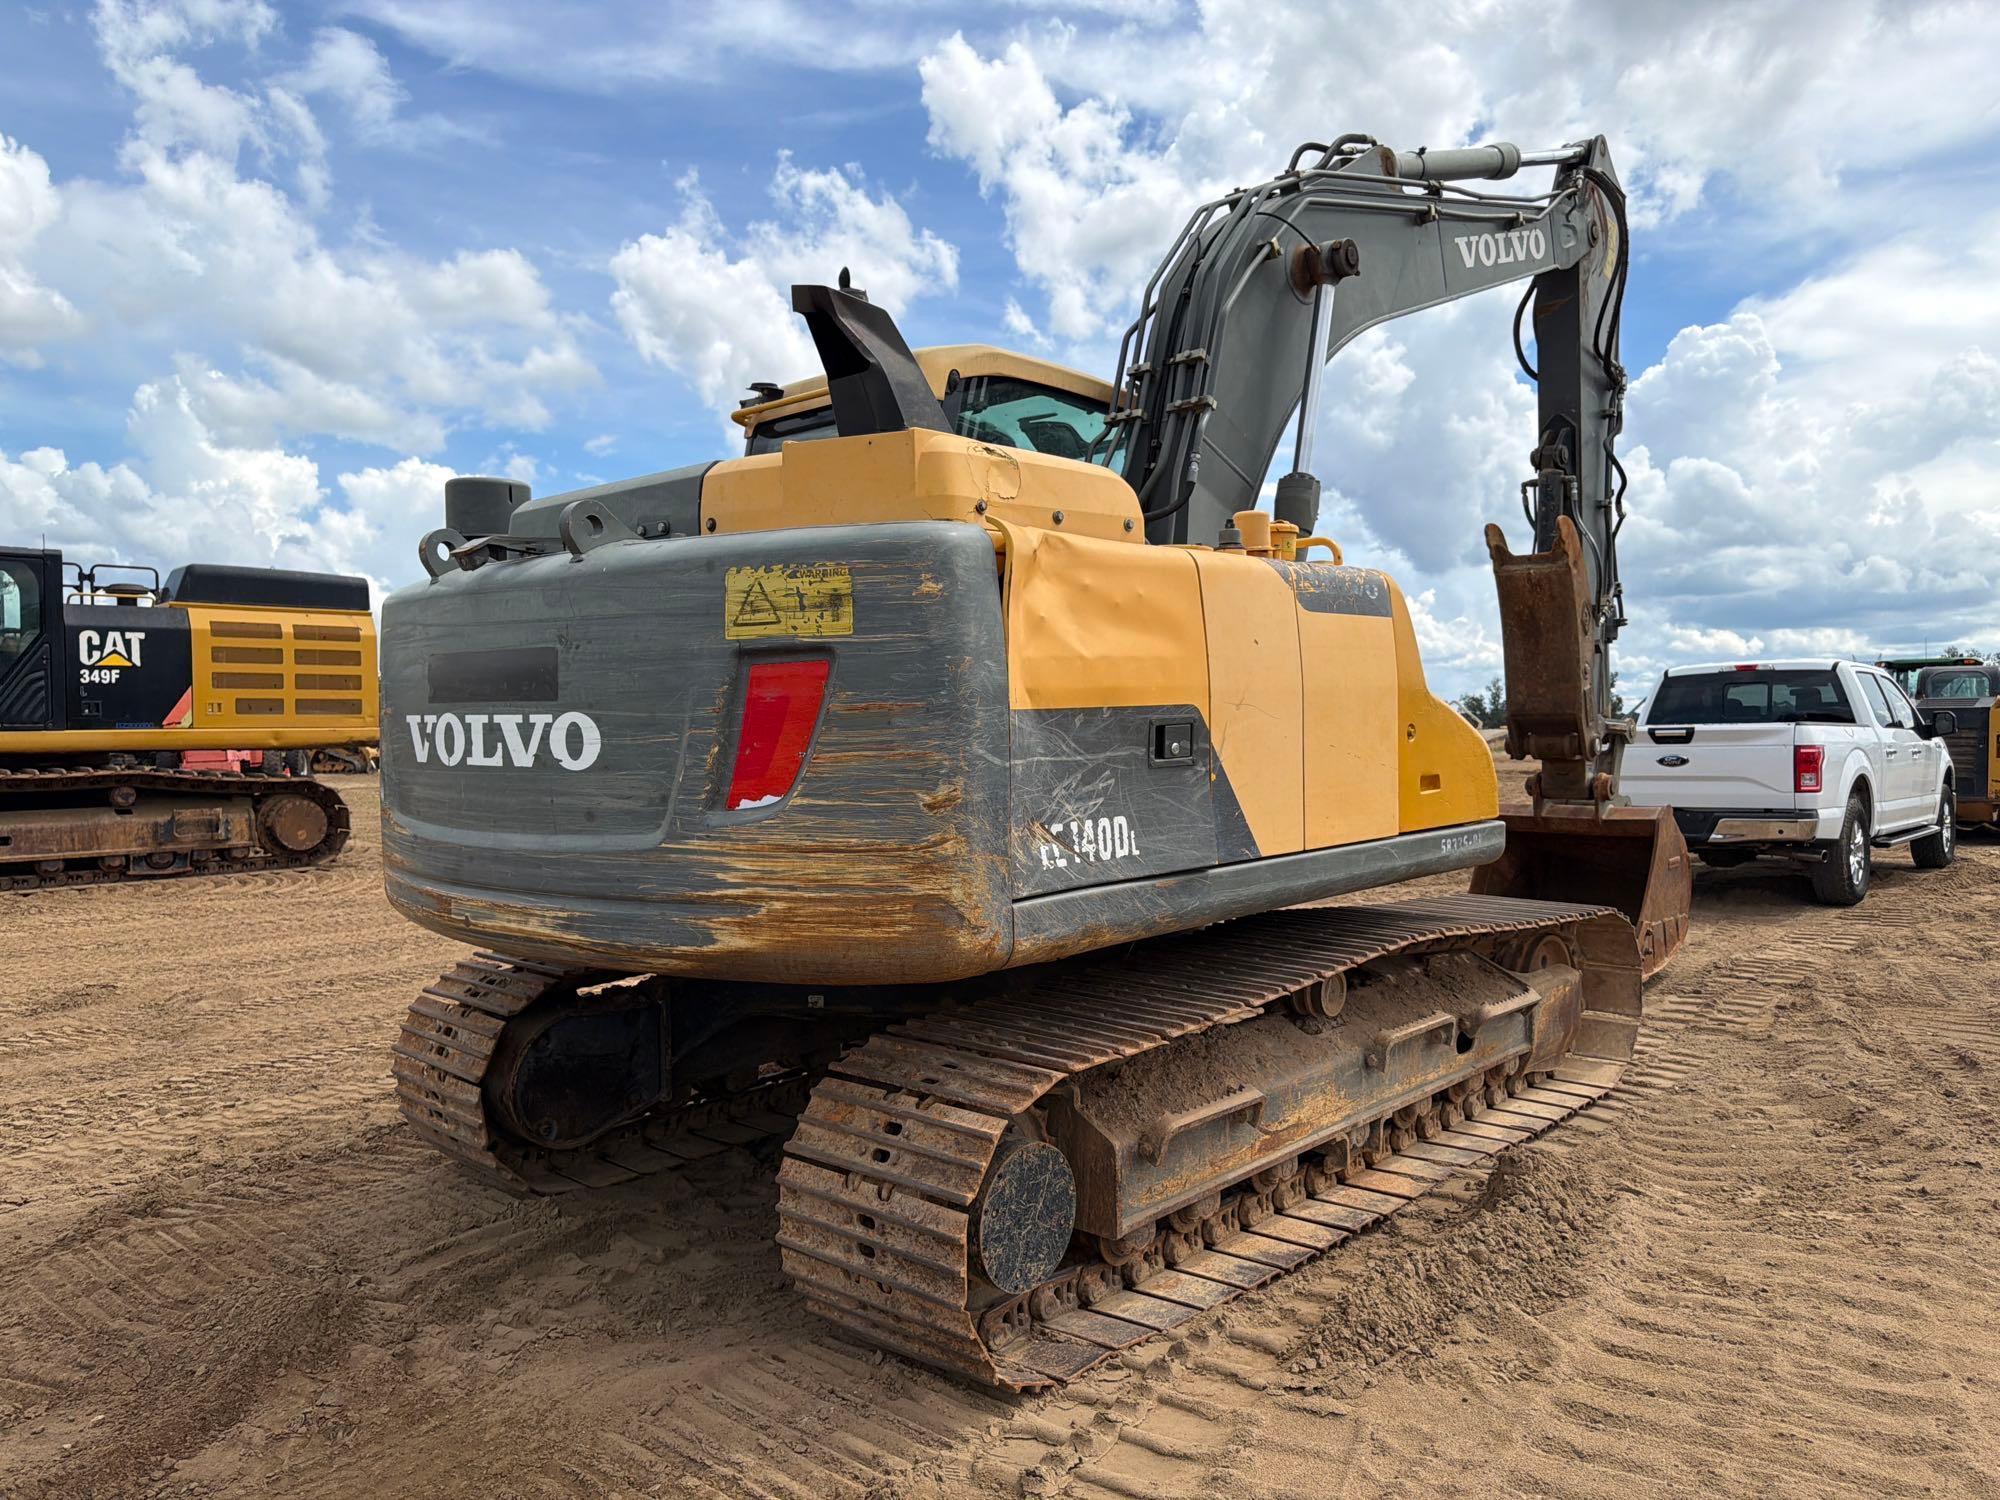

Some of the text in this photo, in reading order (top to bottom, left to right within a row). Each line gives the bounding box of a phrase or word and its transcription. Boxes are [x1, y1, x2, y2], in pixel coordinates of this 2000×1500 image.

[1454, 228, 1546, 269] VOLVO
[78, 629, 146, 667] CAT
[79, 668, 121, 684] 349F
[405, 710, 602, 772] VOLVO
